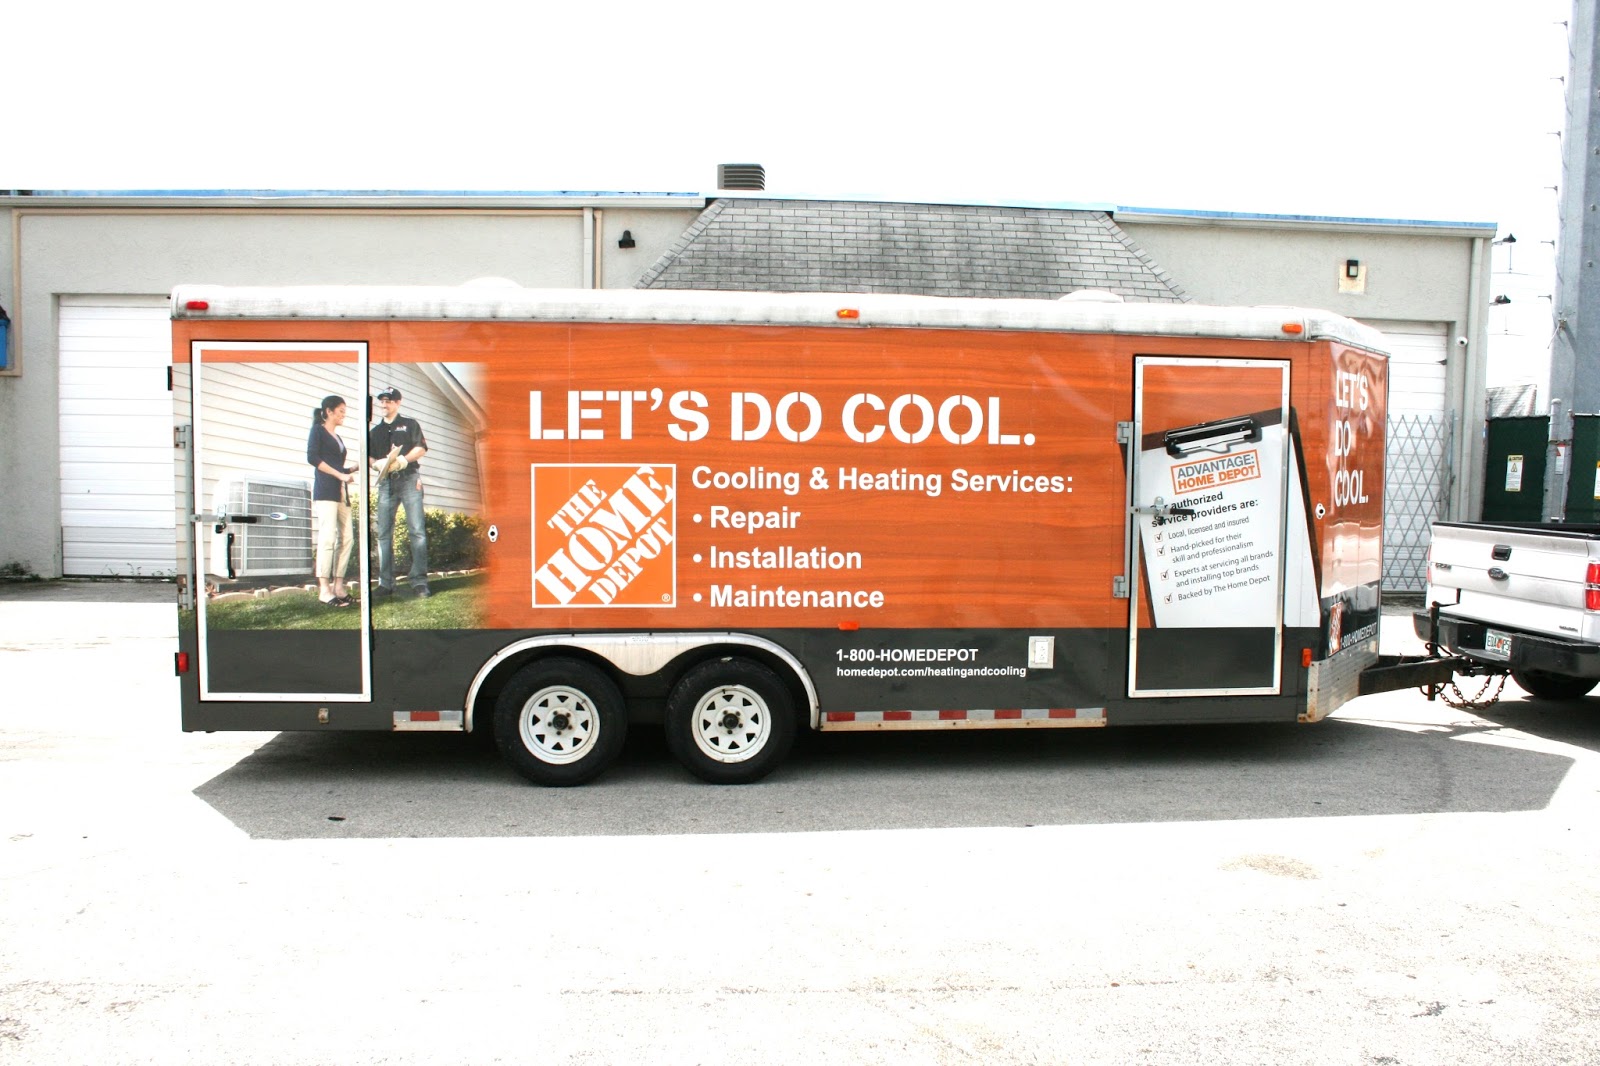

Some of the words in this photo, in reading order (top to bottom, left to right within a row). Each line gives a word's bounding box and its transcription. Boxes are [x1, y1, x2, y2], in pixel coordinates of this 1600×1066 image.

[1336, 369, 1368, 411] LET'S
[529, 388, 709, 442] LET'S
[731, 391, 822, 443] DO
[841, 392, 1035, 446] COOL.
[1335, 419, 1352, 457] DO
[1177, 454, 1255, 479] ADVANTAGE:
[1178, 473, 1214, 490] HOME
[1219, 465, 1255, 481] DEPOT
[691, 466, 801, 495] Cooling
[808, 467, 830, 491] &
[838, 467, 943, 497] Heating
[950, 469, 1074, 493] Services:
[1334, 469, 1369, 507] COOL.
[547, 479, 607, 536] THE
[1152, 513, 1188, 527] srvice
[1190, 503, 1237, 521] providers
[1240, 499, 1258, 509] are:
[1171, 492, 1223, 510] authorized
[709, 505, 801, 533] Repair
[1168, 530, 1187, 540] Local,
[1187, 524, 1212, 535] licensed
[1214, 521, 1225, 530] and
[1227, 516, 1250, 527] insured
[535, 466, 674, 605] HOME
[1170, 538, 1214, 554] Hand-picked
[1215, 536, 1225, 544] for
[1226, 532, 1242, 542] their
[588, 517, 673, 605] DEPOT
[709, 546, 862, 569] Installation
[1172, 556, 1186, 564] skill
[1187, 552, 1200, 561] and
[1201, 541, 1254, 558] professionalism
[1174, 566, 1200, 578] Experts
[1201, 564, 1208, 573] at
[1209, 557, 1239, 571] servicing
[1241, 554, 1249, 563] all
[1250, 550, 1274, 561] brands
[1176, 579, 1189, 588] and
[1190, 573, 1221, 585] installing
[1222, 569, 1235, 580] top
[1236, 564, 1260, 575] brands
[1178, 588, 1203, 601] Backed
[1204, 587, 1213, 597] by
[1213, 583, 1226, 593] The
[1227, 580, 1248, 591] Home
[1249, 575, 1271, 587] Depot
[709, 584, 884, 608] Maintenance
[836, 649, 978, 662] 1-800-HOMEDEPOT
[836, 666, 1026, 678] homedepot.com/heatingandcooling
